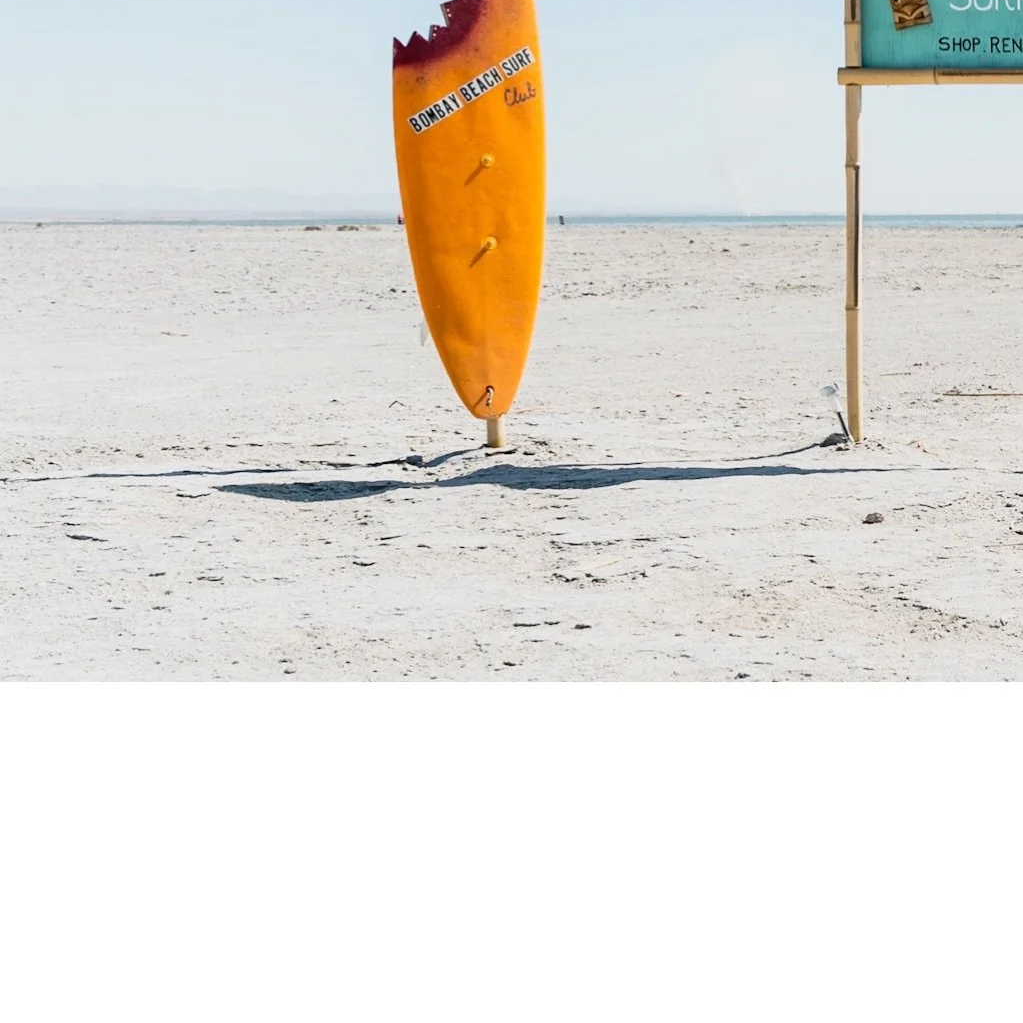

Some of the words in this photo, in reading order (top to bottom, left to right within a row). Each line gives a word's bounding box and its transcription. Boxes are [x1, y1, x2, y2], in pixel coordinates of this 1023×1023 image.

[409, 93, 461, 133] BOMBAY
[459, 67, 503, 102] BEACH
[501, 48, 533, 76] SURF
